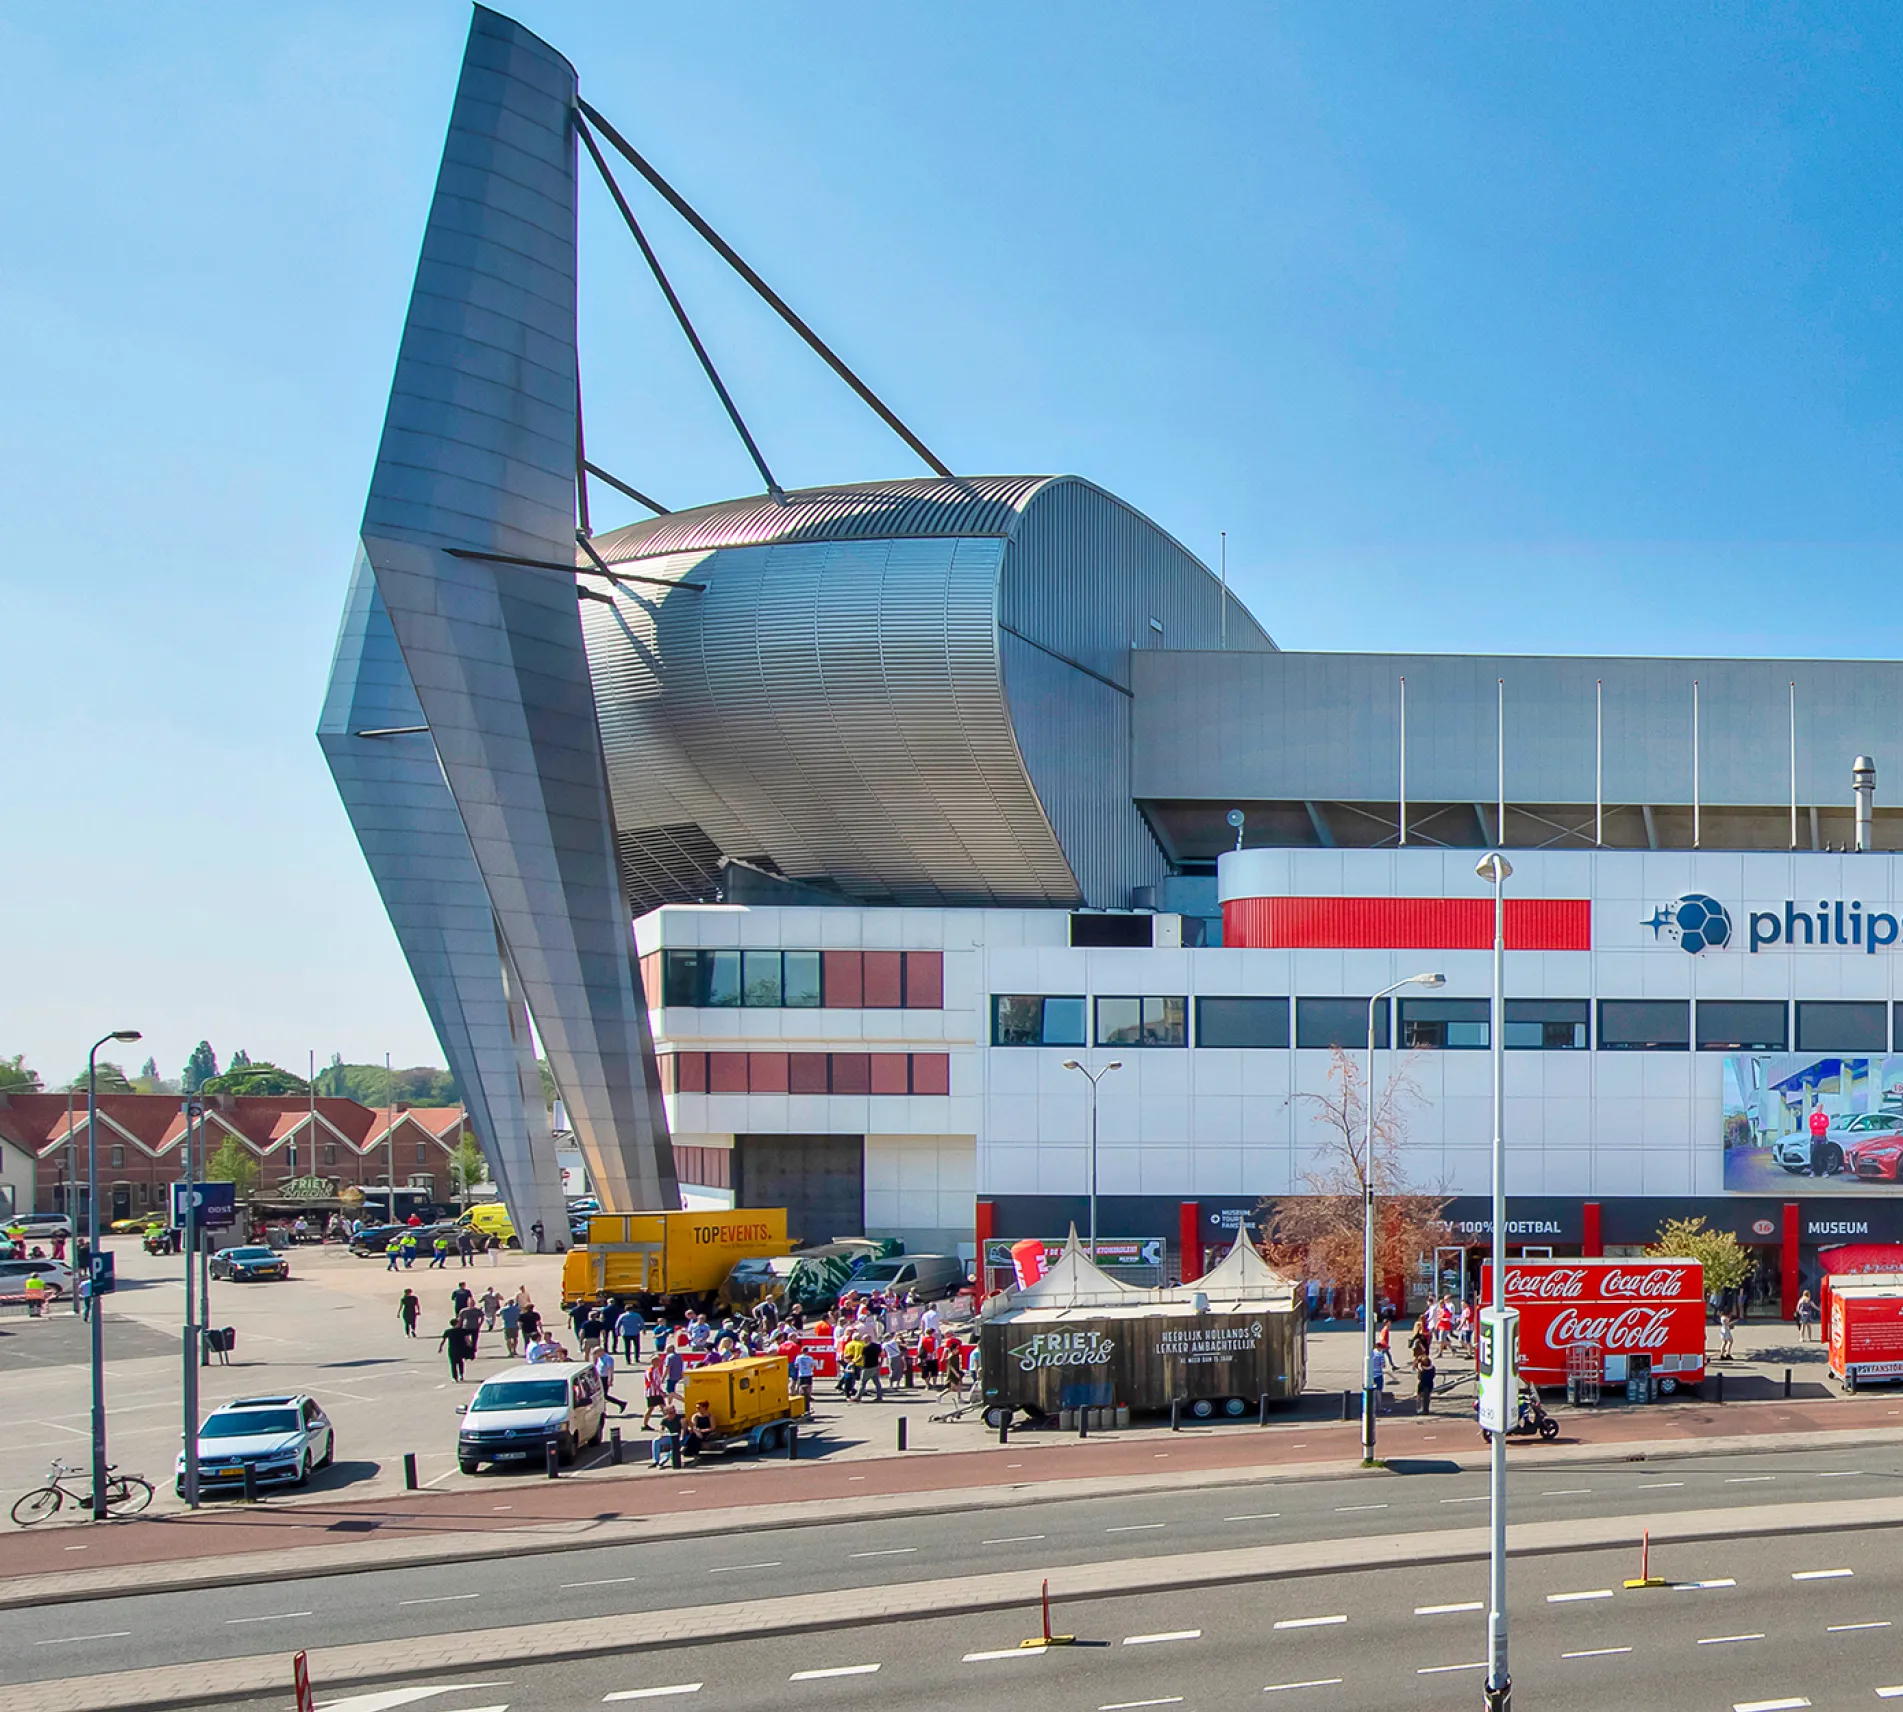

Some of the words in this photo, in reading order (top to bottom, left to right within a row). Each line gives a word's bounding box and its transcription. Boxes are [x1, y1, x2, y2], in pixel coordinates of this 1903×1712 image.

[291, 1178, 328, 1191] FRIET
[208, 1204, 232, 1213] oost
[1808, 1222, 1868, 1234] MUSEUM
[1504, 1269, 1588, 1297] Coca-Cola
[1600, 1269, 1687, 1297] Coca-Cola
[1162, 1329, 1203, 1342] HEERLIJK
[1204, 1328, 1250, 1340] HOLLANDS
[1544, 1307, 1677, 1349] Coca-Cola
[1033, 1332, 1101, 1351] FRIET
[1155, 1342, 1189, 1354] LEKKER
[1191, 1339, 1256, 1352] AMBACHTELIJK
[1019, 1346, 1111, 1371] Snacks
